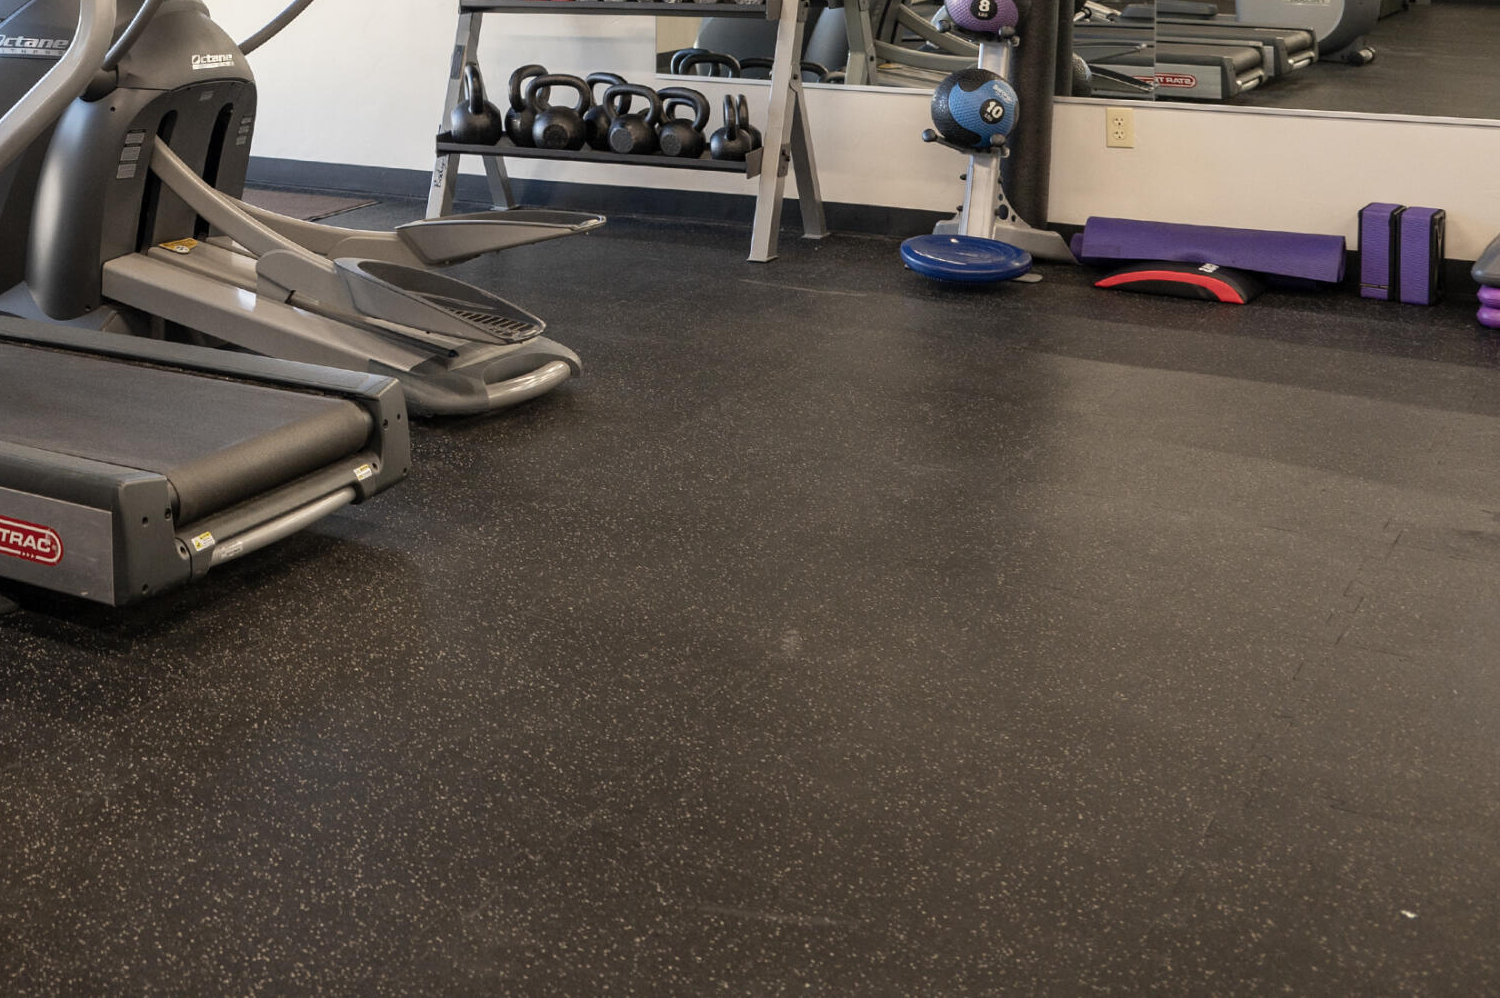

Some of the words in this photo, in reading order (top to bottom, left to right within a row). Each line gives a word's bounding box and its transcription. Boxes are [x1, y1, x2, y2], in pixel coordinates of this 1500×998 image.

[978, 0, 990, 12] 8
[191, 54, 233, 64] Octane
[986, 101, 1003, 119] 10
